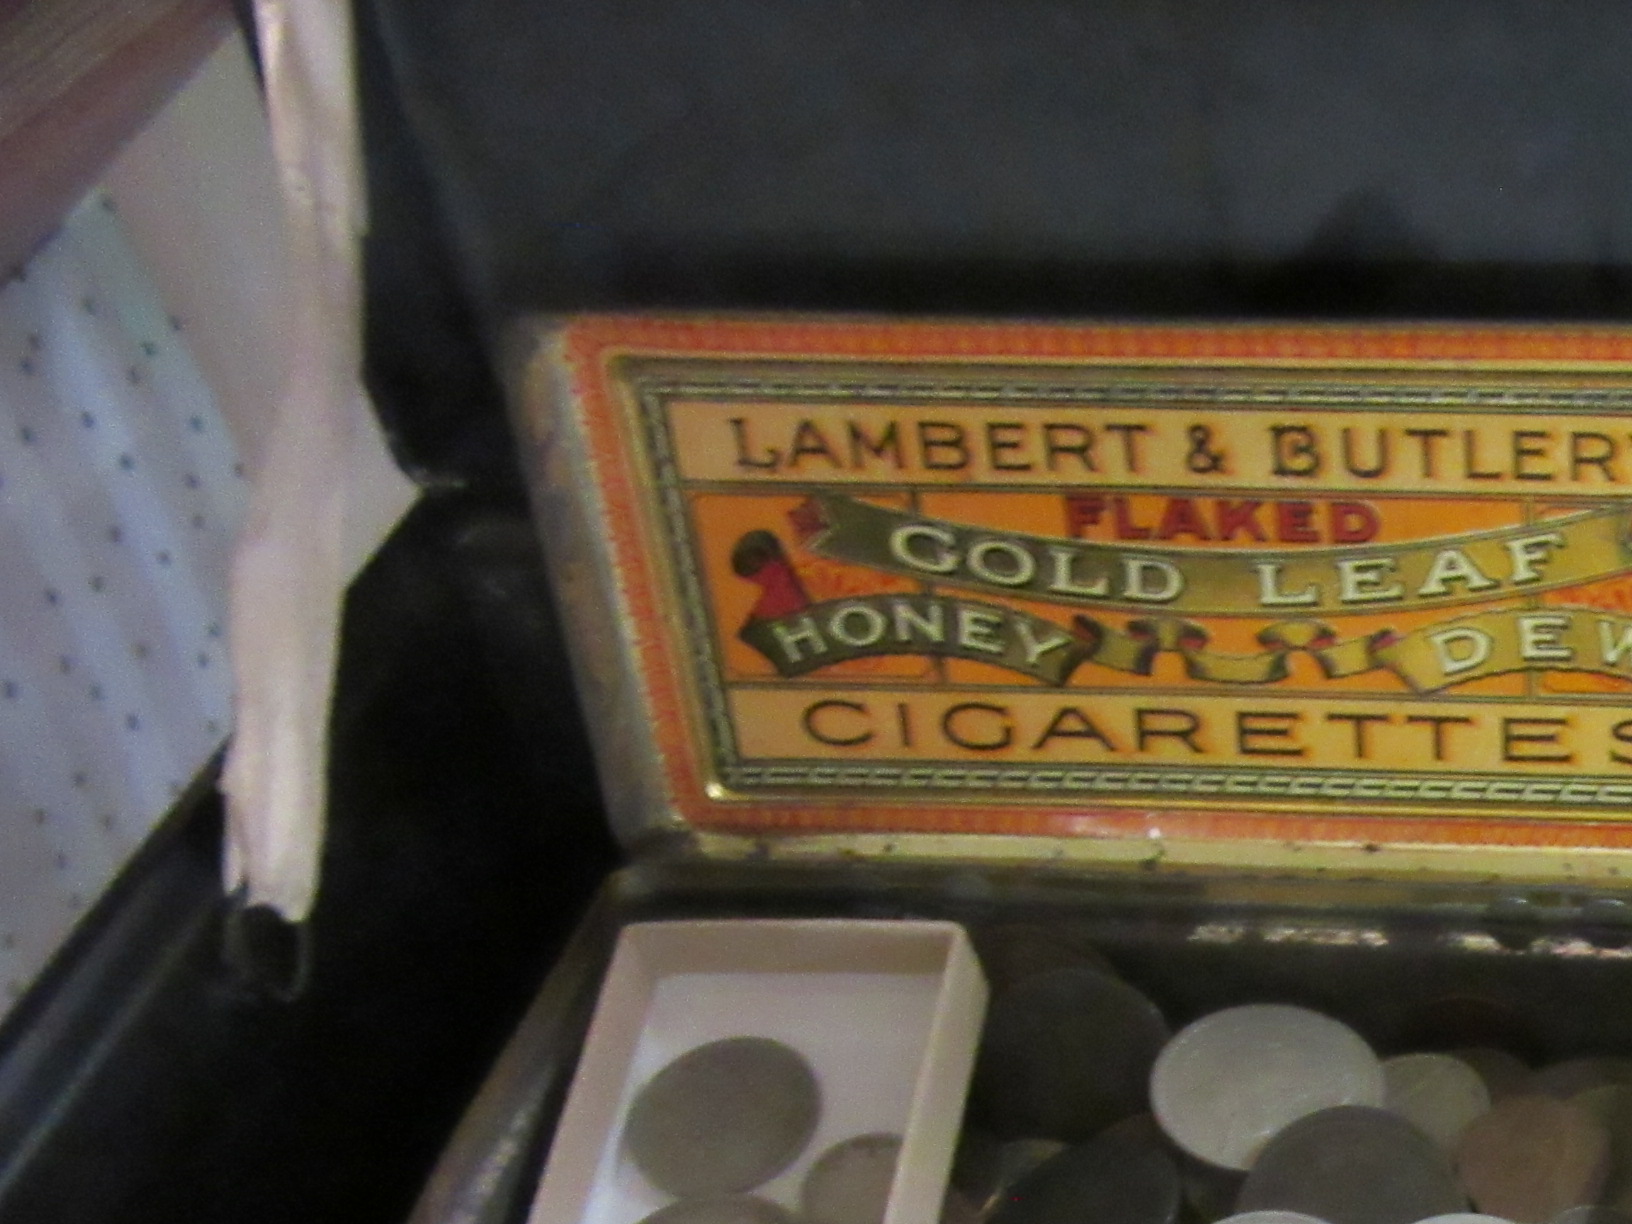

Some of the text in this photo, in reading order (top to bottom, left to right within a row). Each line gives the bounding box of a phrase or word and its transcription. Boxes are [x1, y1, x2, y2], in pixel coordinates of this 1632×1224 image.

[728, 416, 1150, 473] LAMBERT
[1184, 422, 1226, 475] &
[1064, 495, 1381, 544] FLAKED
[889, 522, 1566, 608] GOLD LEAF
[772, 602, 1074, 666] HONEY
